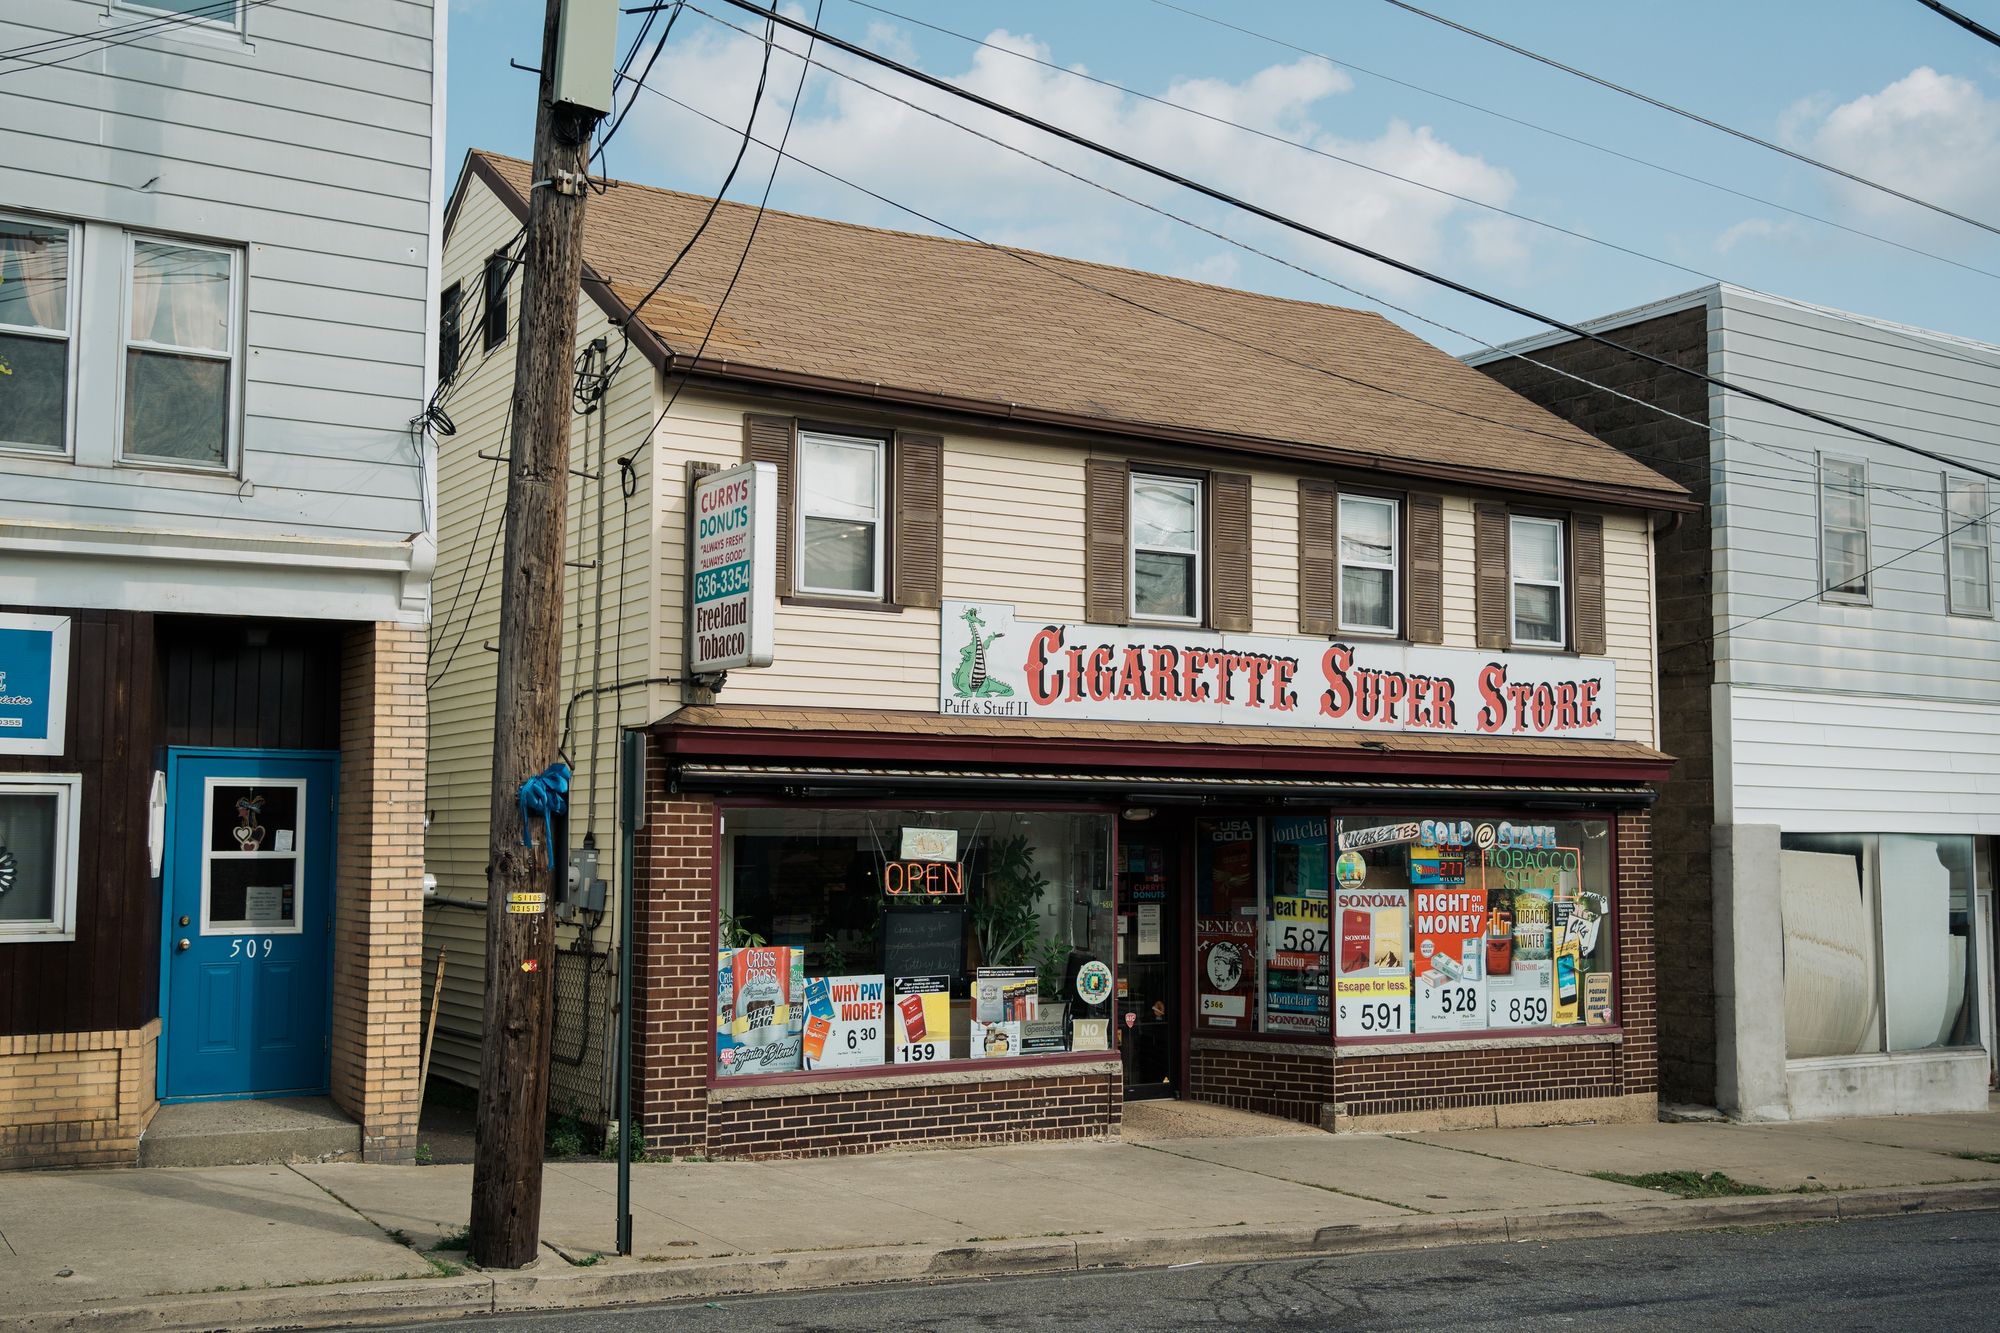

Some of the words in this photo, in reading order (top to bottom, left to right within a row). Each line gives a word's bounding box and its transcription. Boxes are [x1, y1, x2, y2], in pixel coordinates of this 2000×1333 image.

[700, 505, 748, 539] DONUTS
[697, 564, 749, 599] 636-3354
[696, 597, 747, 633] Freeland
[699, 631, 745, 662] Tobacco
[1023, 624, 1299, 713] CIGARETTE
[1318, 643, 1458, 730] SUPER
[1476, 661, 1602, 733] STORE
[943, 698, 970, 715] Puff
[972, 704, 981, 715] &
[983, 699, 1014, 716] Stuff
[1016, 701, 1029, 716] II
[1220, 821, 1251, 831] USA
[1420, 820, 1473, 847] SOLD
[1475, 823, 1495, 848] @
[1212, 831, 1253, 842] GOLD
[1440, 862, 1463, 876] 277
[1488, 848, 1577, 872] TOBACCO
[885, 862, 963, 895] OPEN
[1133, 883, 1166, 891] CURRYS
[1132, 891, 1166, 899] DONUTS
[1338, 894, 1407, 908] SONOMA
[1417, 893, 1470, 912] RIGHT
[1471, 894, 1482, 903] on
[1471, 903, 1485, 913] the
[1517, 909, 1548, 924] TOBACCO
[1197, 920, 1253, 934] SENECA
[1418, 915, 1481, 934] MONEY
[230, 938, 273, 959] 509
[1283, 926, 1329, 952] 587
[1520, 933, 1545, 949] WATER
[1514, 962, 1538, 971] Winston
[745, 968, 777, 987] CROSS
[1337, 982, 1370, 994] Escape
[1372, 981, 1385, 991] for
[1387, 980, 1408, 991] less.
[832, 984, 859, 1003] WHY
[861, 983, 883, 1001] PAY
[1268, 992, 1311, 1006] Montclair
[1425, 988, 1430, 999] $
[1442, 987, 1477, 1014] 5.28
[747, 1004, 775, 1022] MEGA
[842, 1002, 883, 1022] MORE?
[1204, 1000, 1210, 1008] $
[1490, 999, 1497, 1012] $
[1509, 997, 1548, 1024] 8.59
[749, 1016, 773, 1030] BAG
[1267, 1014, 1316, 1026] SONOMA
[1339, 1005, 1347, 1020] $
[1361, 1003, 1401, 1032] 5.91
[1081, 1023, 1099, 1037] NO
[760, 1039, 799, 1066] Blend
[901, 1043, 935, 1062] 159
